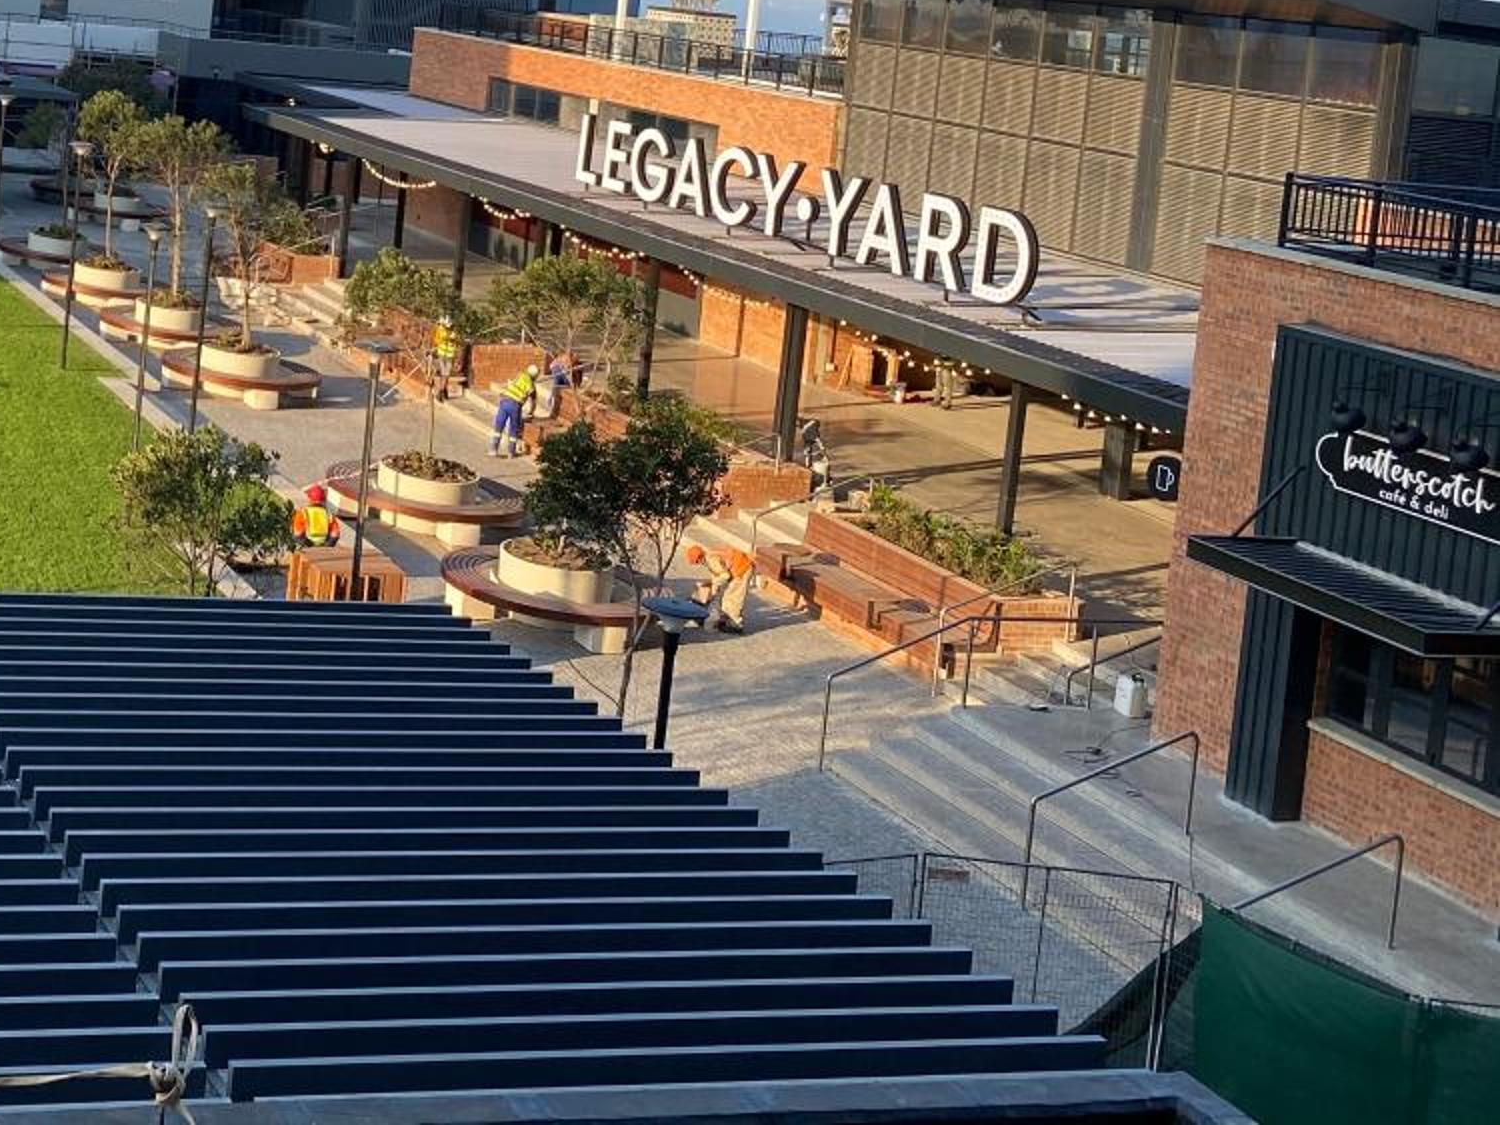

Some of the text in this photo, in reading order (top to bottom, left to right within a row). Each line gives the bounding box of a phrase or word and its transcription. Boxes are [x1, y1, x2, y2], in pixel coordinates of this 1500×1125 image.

[1343, 435, 1496, 515] butterscotch
[1409, 495, 1420, 510] &
[1423, 500, 1449, 520] deli
